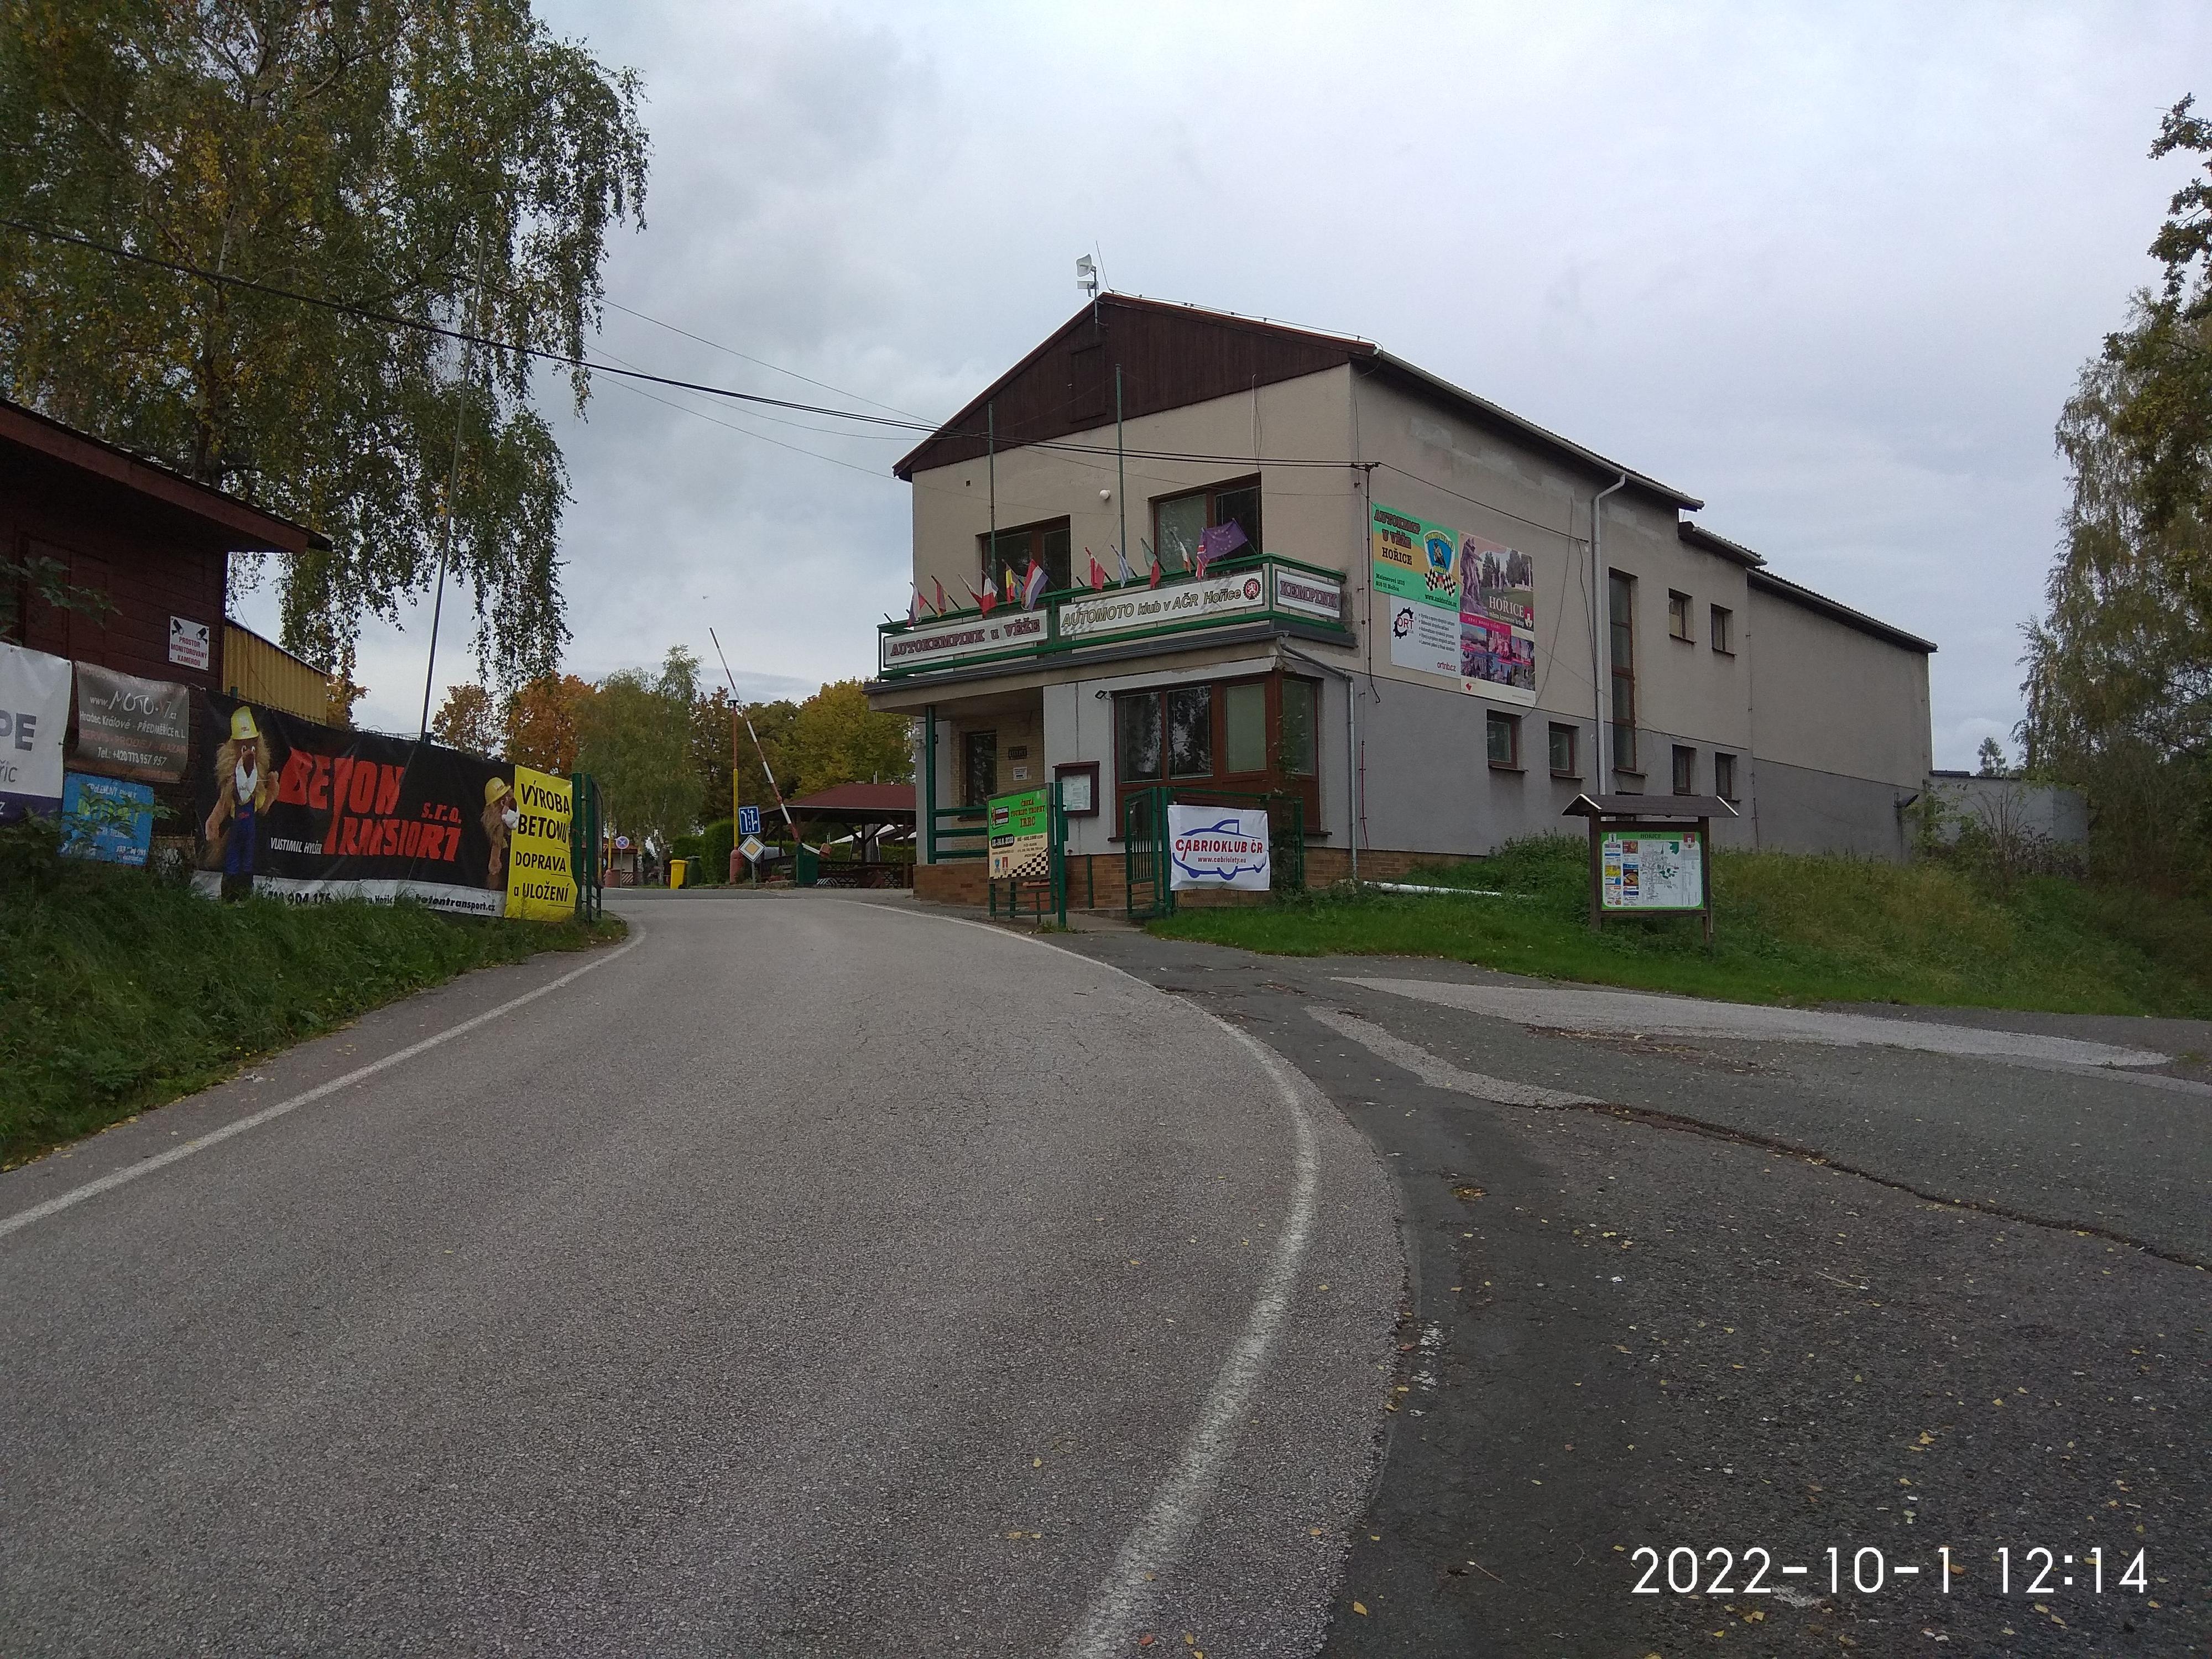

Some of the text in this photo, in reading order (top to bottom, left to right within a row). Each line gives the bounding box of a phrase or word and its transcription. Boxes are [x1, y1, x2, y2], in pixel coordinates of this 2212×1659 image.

[1381, 529, 1389, 541] U
[1381, 547, 1412, 566] HOŘICE
[1280, 580, 1337, 608] KEMPINK
[1061, 588, 1241, 628] AUTOMOTO klub v AČR Hořice
[1489, 596, 1524, 618] HOŘICE
[1397, 617, 1414, 629] ORT
[179, 636, 200, 648] PROSTOR
[890, 629, 985, 656] AUTOKEMPINK
[1004, 617, 1040, 637] VĚŽE
[178, 655, 200, 666] KAMEROU
[1437, 661, 1456, 672] ortnb.cz
[79, 711, 101, 724] Hradec
[102, 716, 131, 729] Králové
[113, 750, 128, 761] +420
[140, 754, 153, 765] 957
[153, 755, 168, 766] 957
[277, 747, 405, 818] BETON
[520, 780, 570, 816] VÝROBA
[518, 814, 566, 843] BETONU
[1020, 816, 1036, 828] IRRC
[270, 837, 302, 853] VLASTIMIL
[1175, 839, 1262, 860] CABRIOKLUB ČR
[515, 851, 566, 872] DOPRAVA
[1198, 856, 1246, 864] www.cabriolety.eu
[514, 881, 570, 901] a ULOŽENÍ
